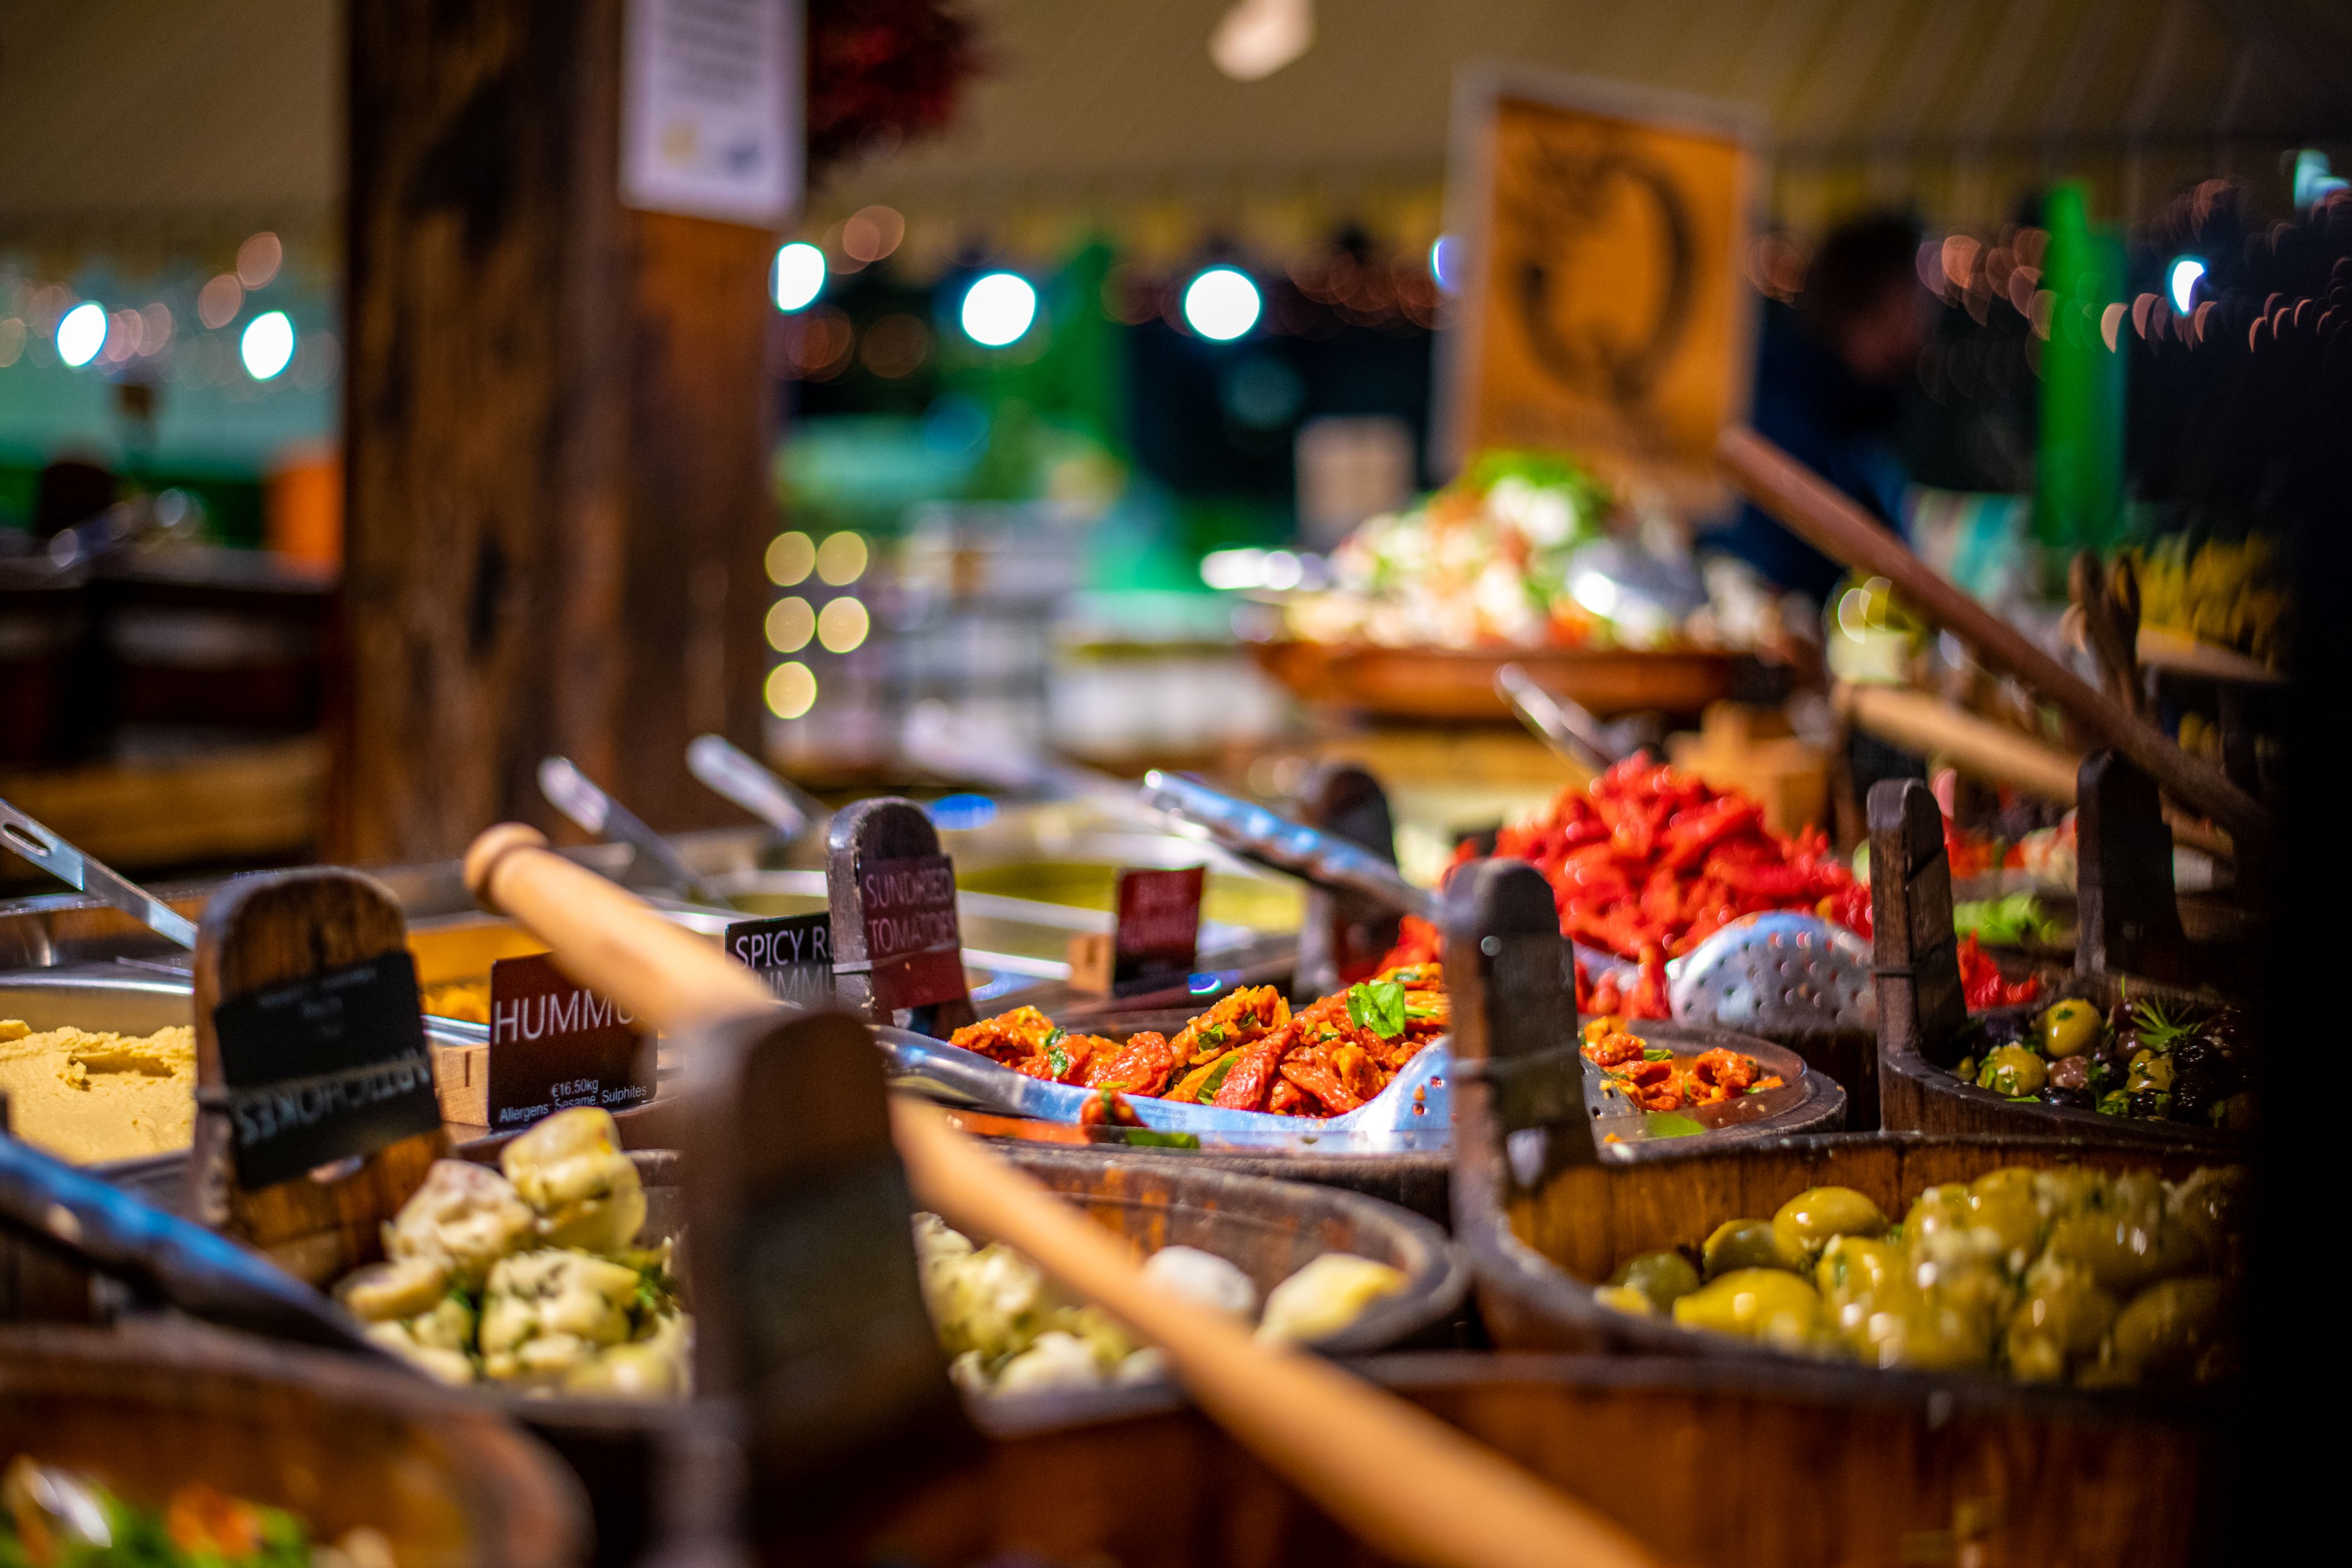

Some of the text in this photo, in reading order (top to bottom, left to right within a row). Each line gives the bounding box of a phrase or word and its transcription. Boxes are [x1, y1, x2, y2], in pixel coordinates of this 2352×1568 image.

[735, 928, 805, 969] SPICY
[499, 1103, 552, 1123] Allergens:
[602, 1084, 647, 1105] Sulphites
[551, 1078, 599, 1098] €16.50kg
